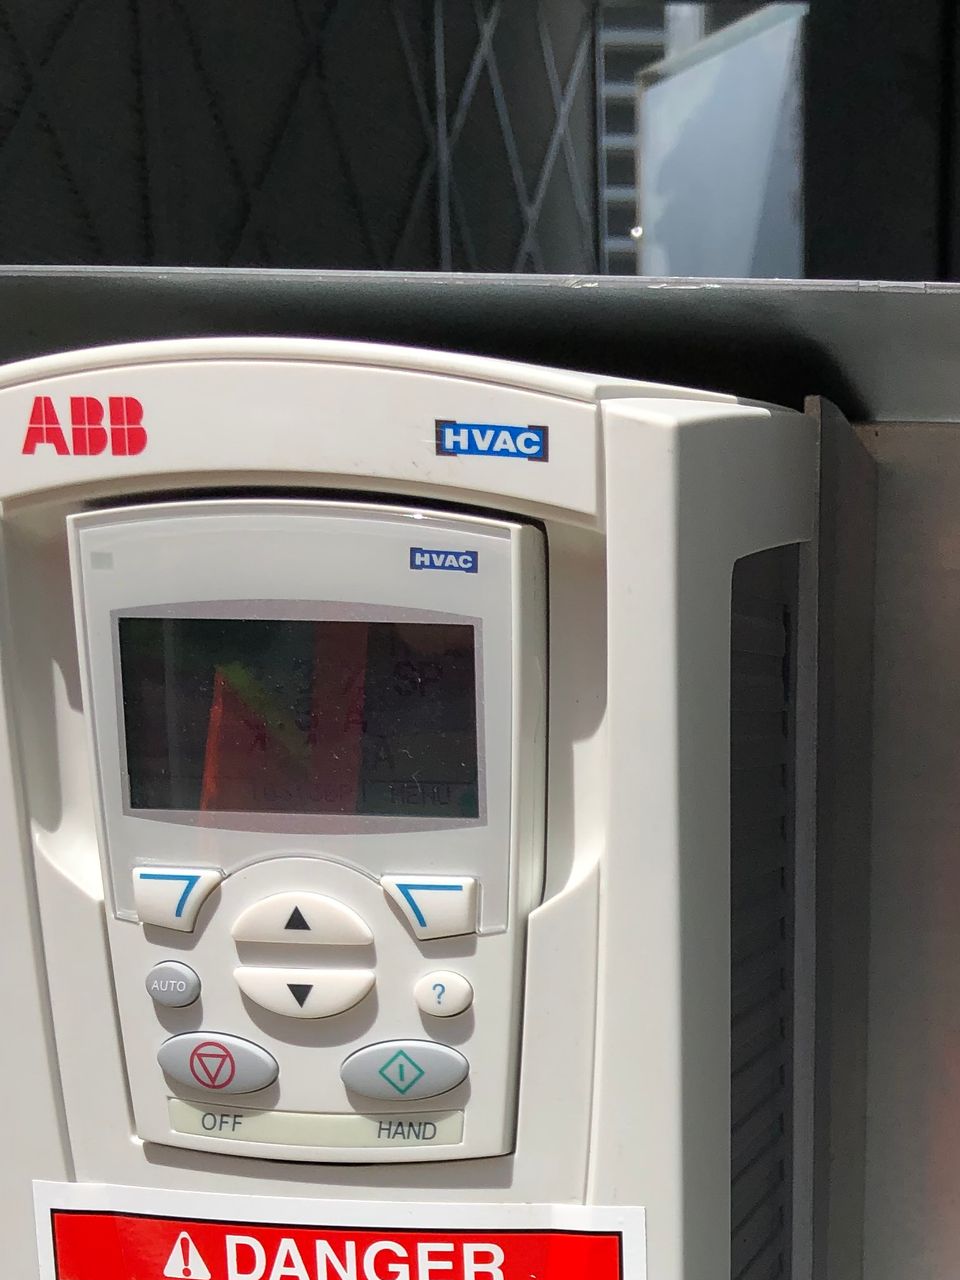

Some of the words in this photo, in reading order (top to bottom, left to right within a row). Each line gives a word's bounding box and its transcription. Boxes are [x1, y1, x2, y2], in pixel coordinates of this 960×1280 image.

[21, 396, 149, 456] ABB
[443, 424, 544, 458] HVAC
[413, 550, 475, 570] HVAC
[150, 976, 188, 993] AUTO
[200, 1112, 245, 1134] OFF
[376, 1120, 438, 1142] HAND
